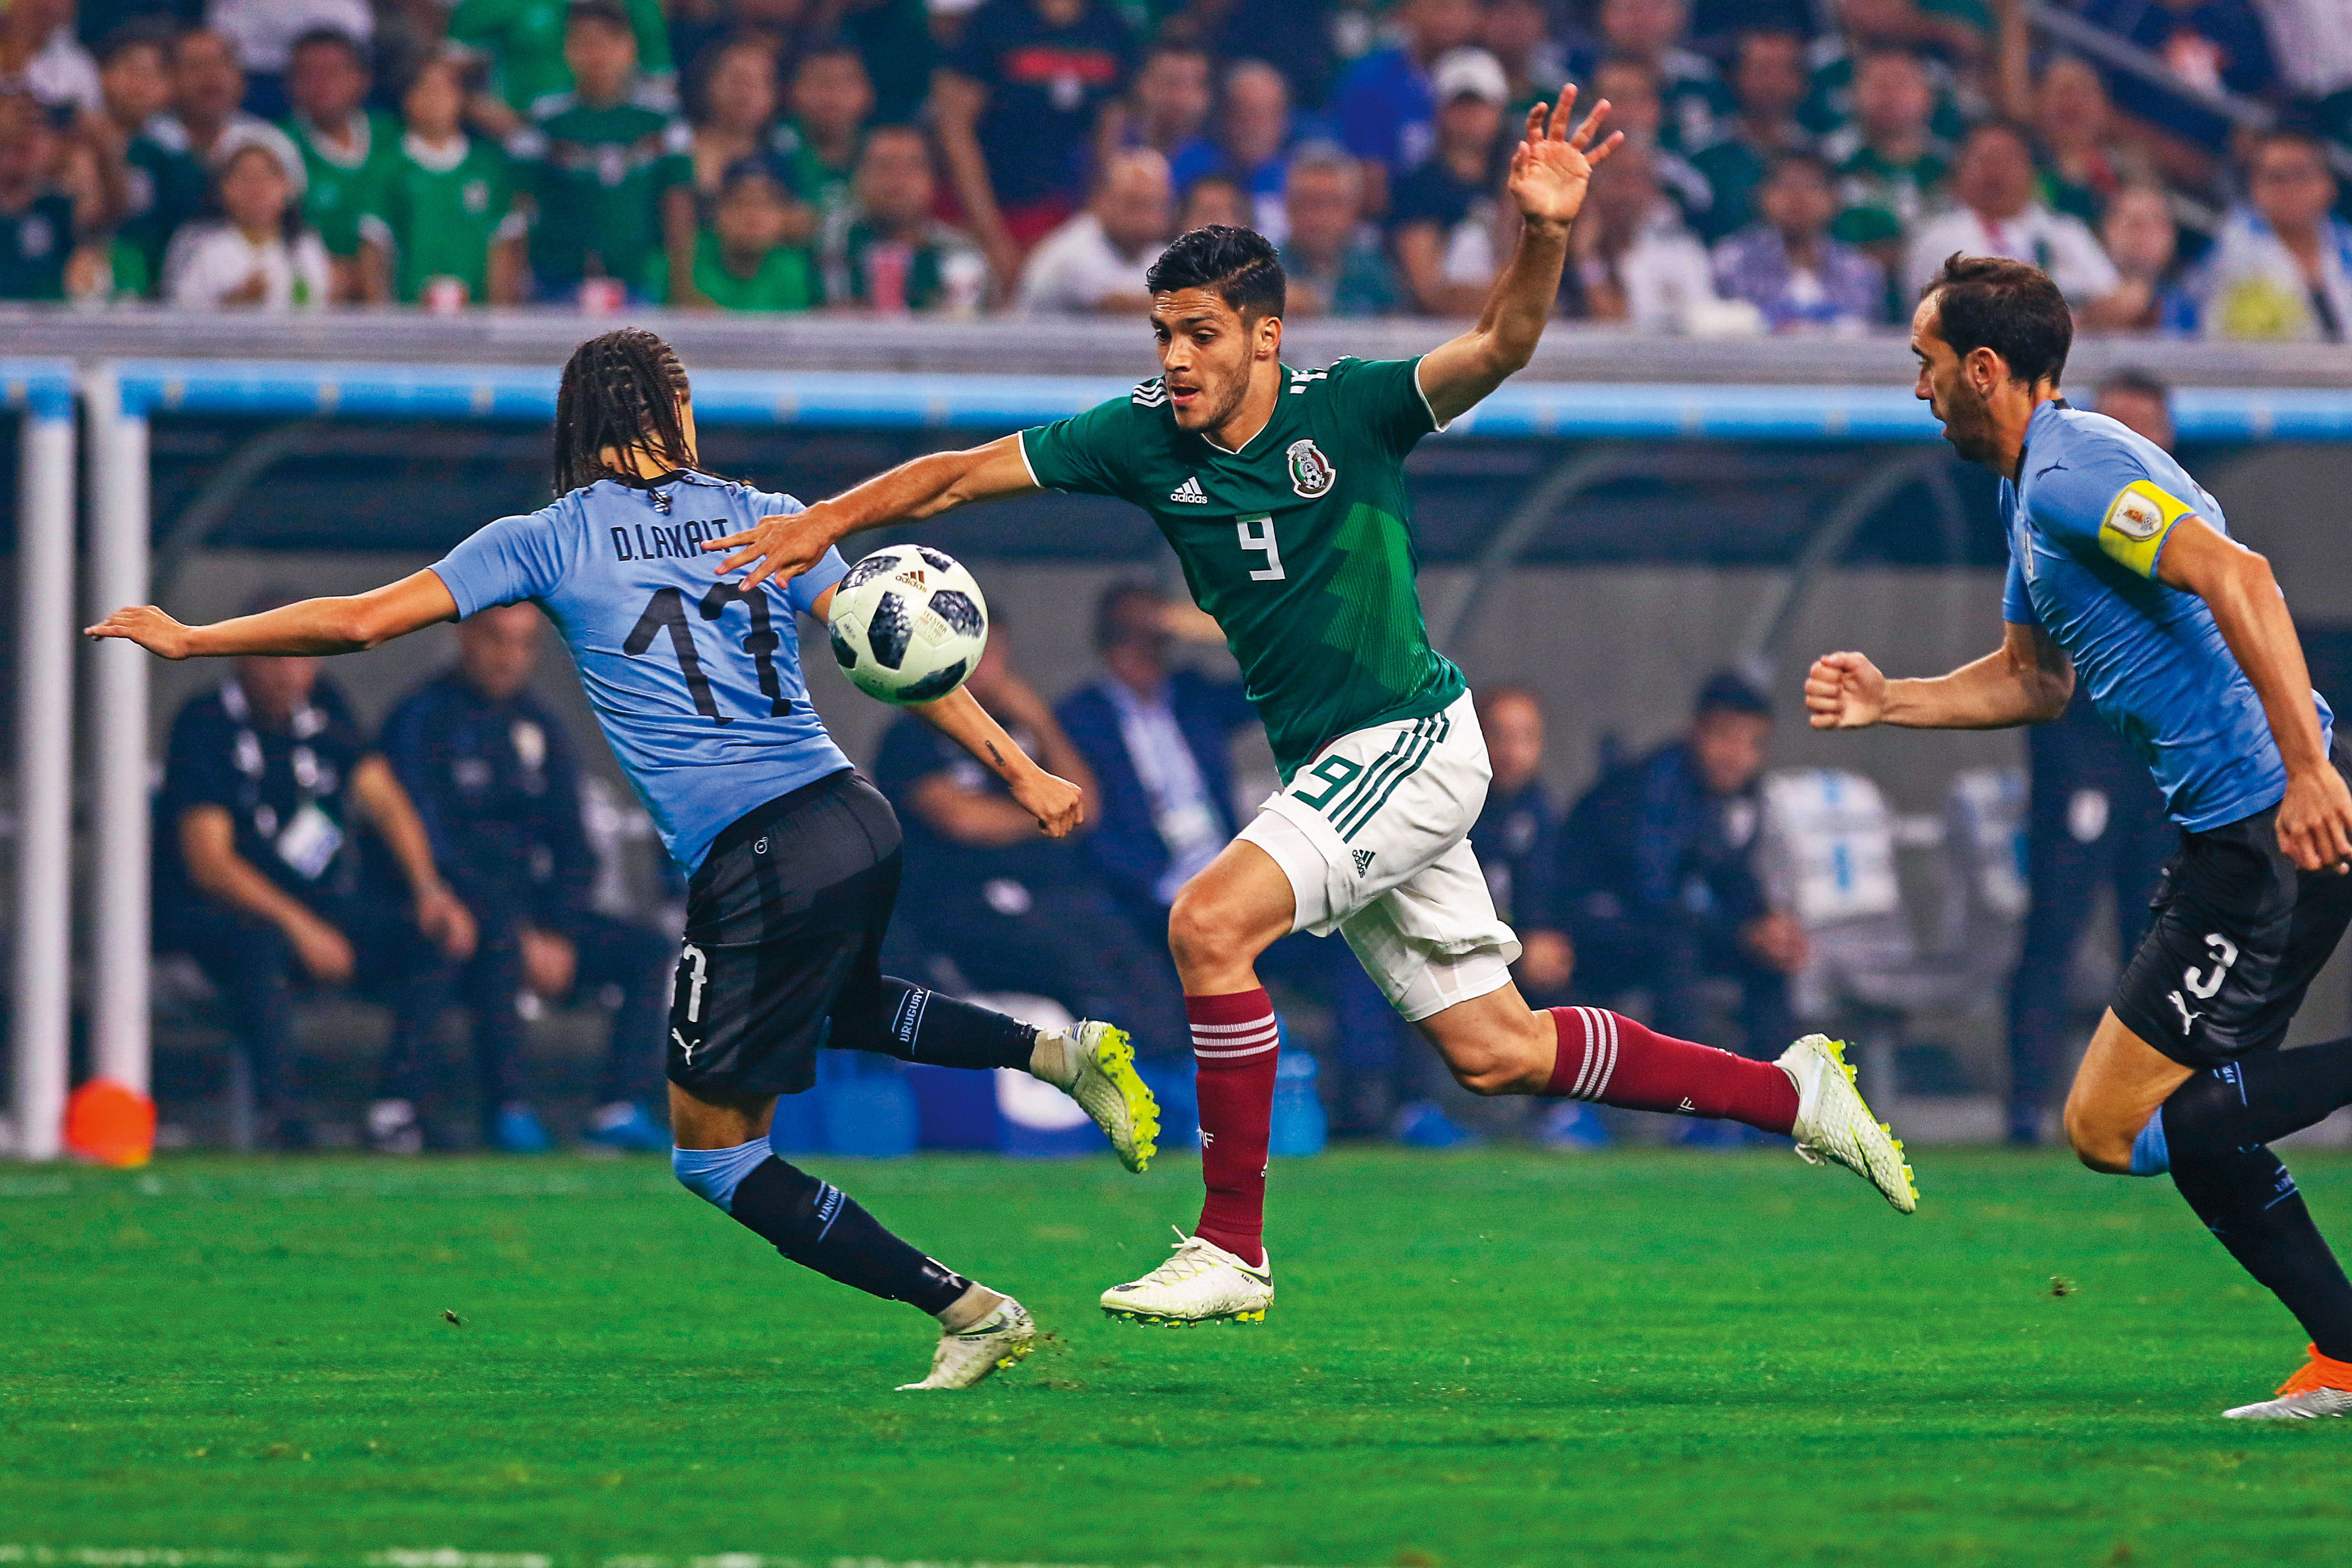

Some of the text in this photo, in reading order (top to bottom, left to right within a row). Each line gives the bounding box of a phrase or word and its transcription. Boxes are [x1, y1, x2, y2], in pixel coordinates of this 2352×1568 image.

[1171, 492, 1208, 504] adidas
[1236, 512, 1286, 581] 9
[895, 576, 927, 593] adidas
[623, 578, 792, 726] 17
[1291, 755, 1364, 811] 9
[1352, 849, 1366, 879] adidas
[2184, 933, 2239, 999] 3
[900, 988, 924, 1043] URUGUAY
